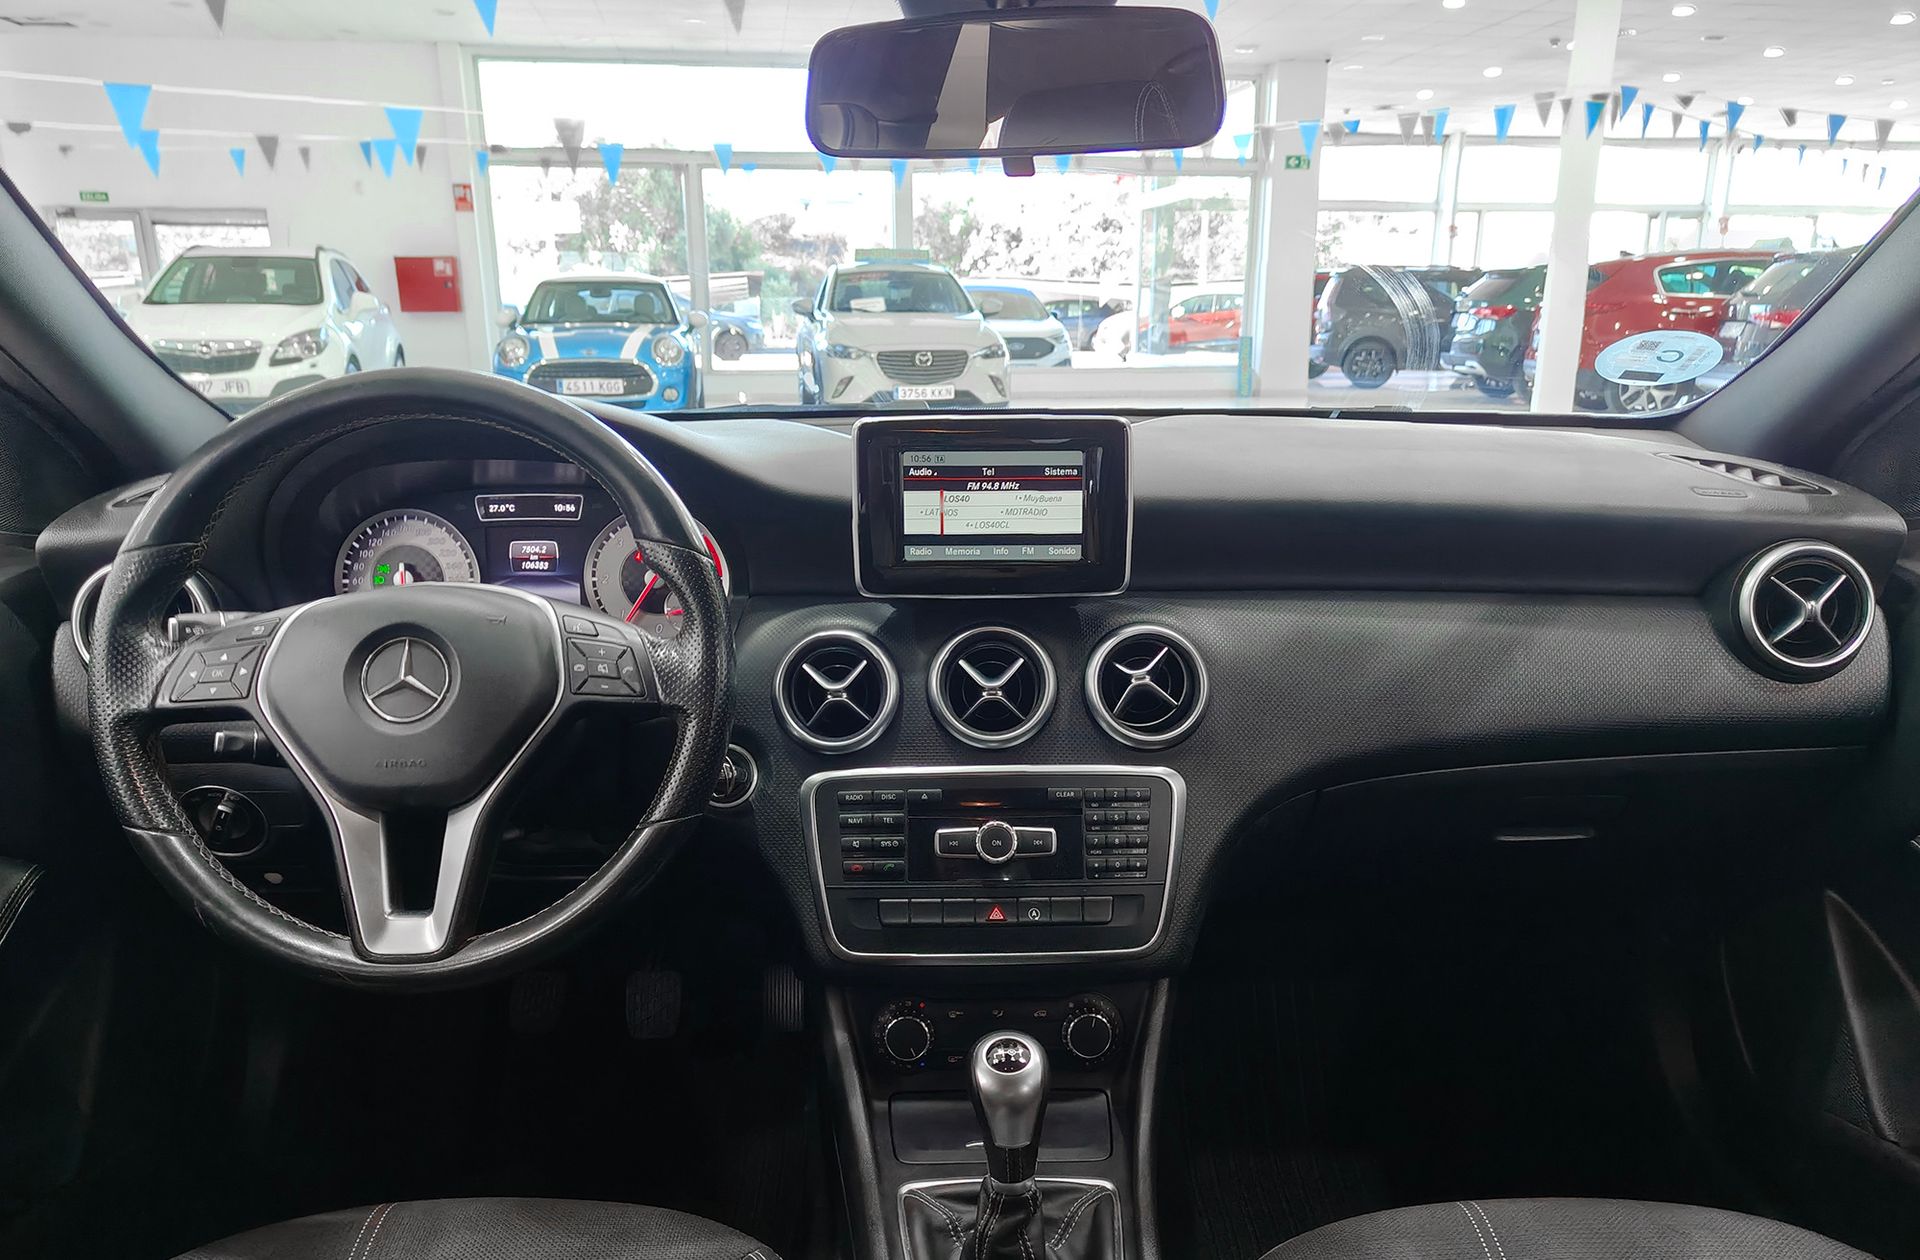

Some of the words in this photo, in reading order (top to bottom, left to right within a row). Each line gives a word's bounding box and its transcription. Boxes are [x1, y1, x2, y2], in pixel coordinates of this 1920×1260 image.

[566, 381, 594, 392] 4511
[900, 389, 927, 398] 3756
[909, 467, 933, 476] Audio
[982, 468, 994, 476] Tel
[1044, 467, 1078, 476] Sistema
[967, 482, 980, 490] FM
[981, 482, 1000, 490] 94.8
[1000, 482, 1020, 490] MHz
[1023, 494, 1062, 504] MuyBuena
[489, 504, 515, 512] 27.0°C
[554, 504, 575, 512] 10:56
[924, 508, 958, 516] LATNOS
[1005, 508, 1048, 516] MDTRADIO
[975, 521, 1010, 529] LOS40CL
[368, 538, 383, 547] 120
[360, 549, 374, 558] 100
[910, 547, 932, 556] Radio
[945, 547, 980, 556] Memoria
[1049, 547, 1076, 555] Sonido
[352, 576, 364, 585] 60
[212, 669, 224, 677] OK
